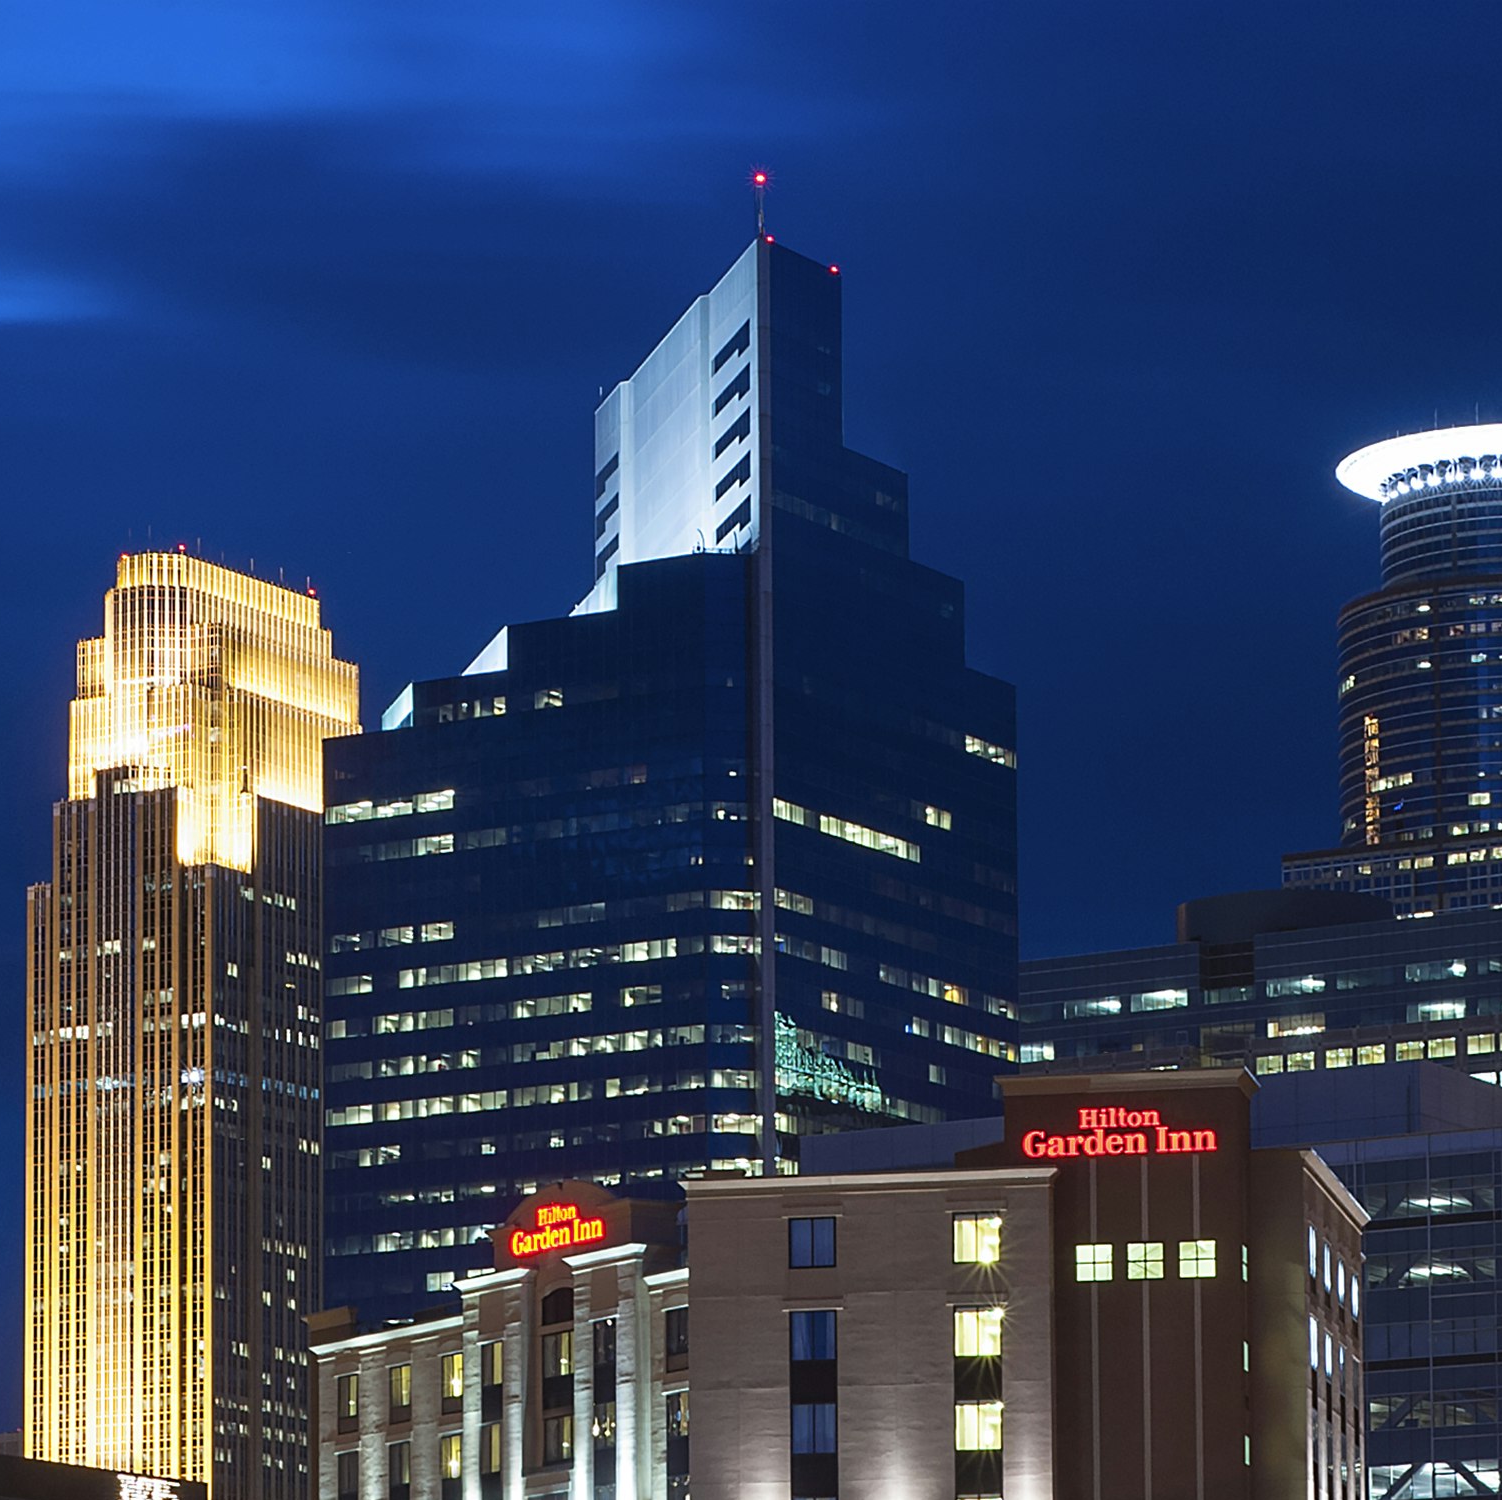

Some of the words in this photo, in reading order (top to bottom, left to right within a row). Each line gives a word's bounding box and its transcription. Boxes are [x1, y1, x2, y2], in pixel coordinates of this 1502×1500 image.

[1078, 1107, 1160, 1129] Hilton
[1022, 1127, 1148, 1158] Garden
[1156, 1126, 1217, 1152] Inn
[537, 1205, 576, 1227] Hilton
[512, 1226, 571, 1255] Garden
[573, 1218, 603, 1242] Inn
